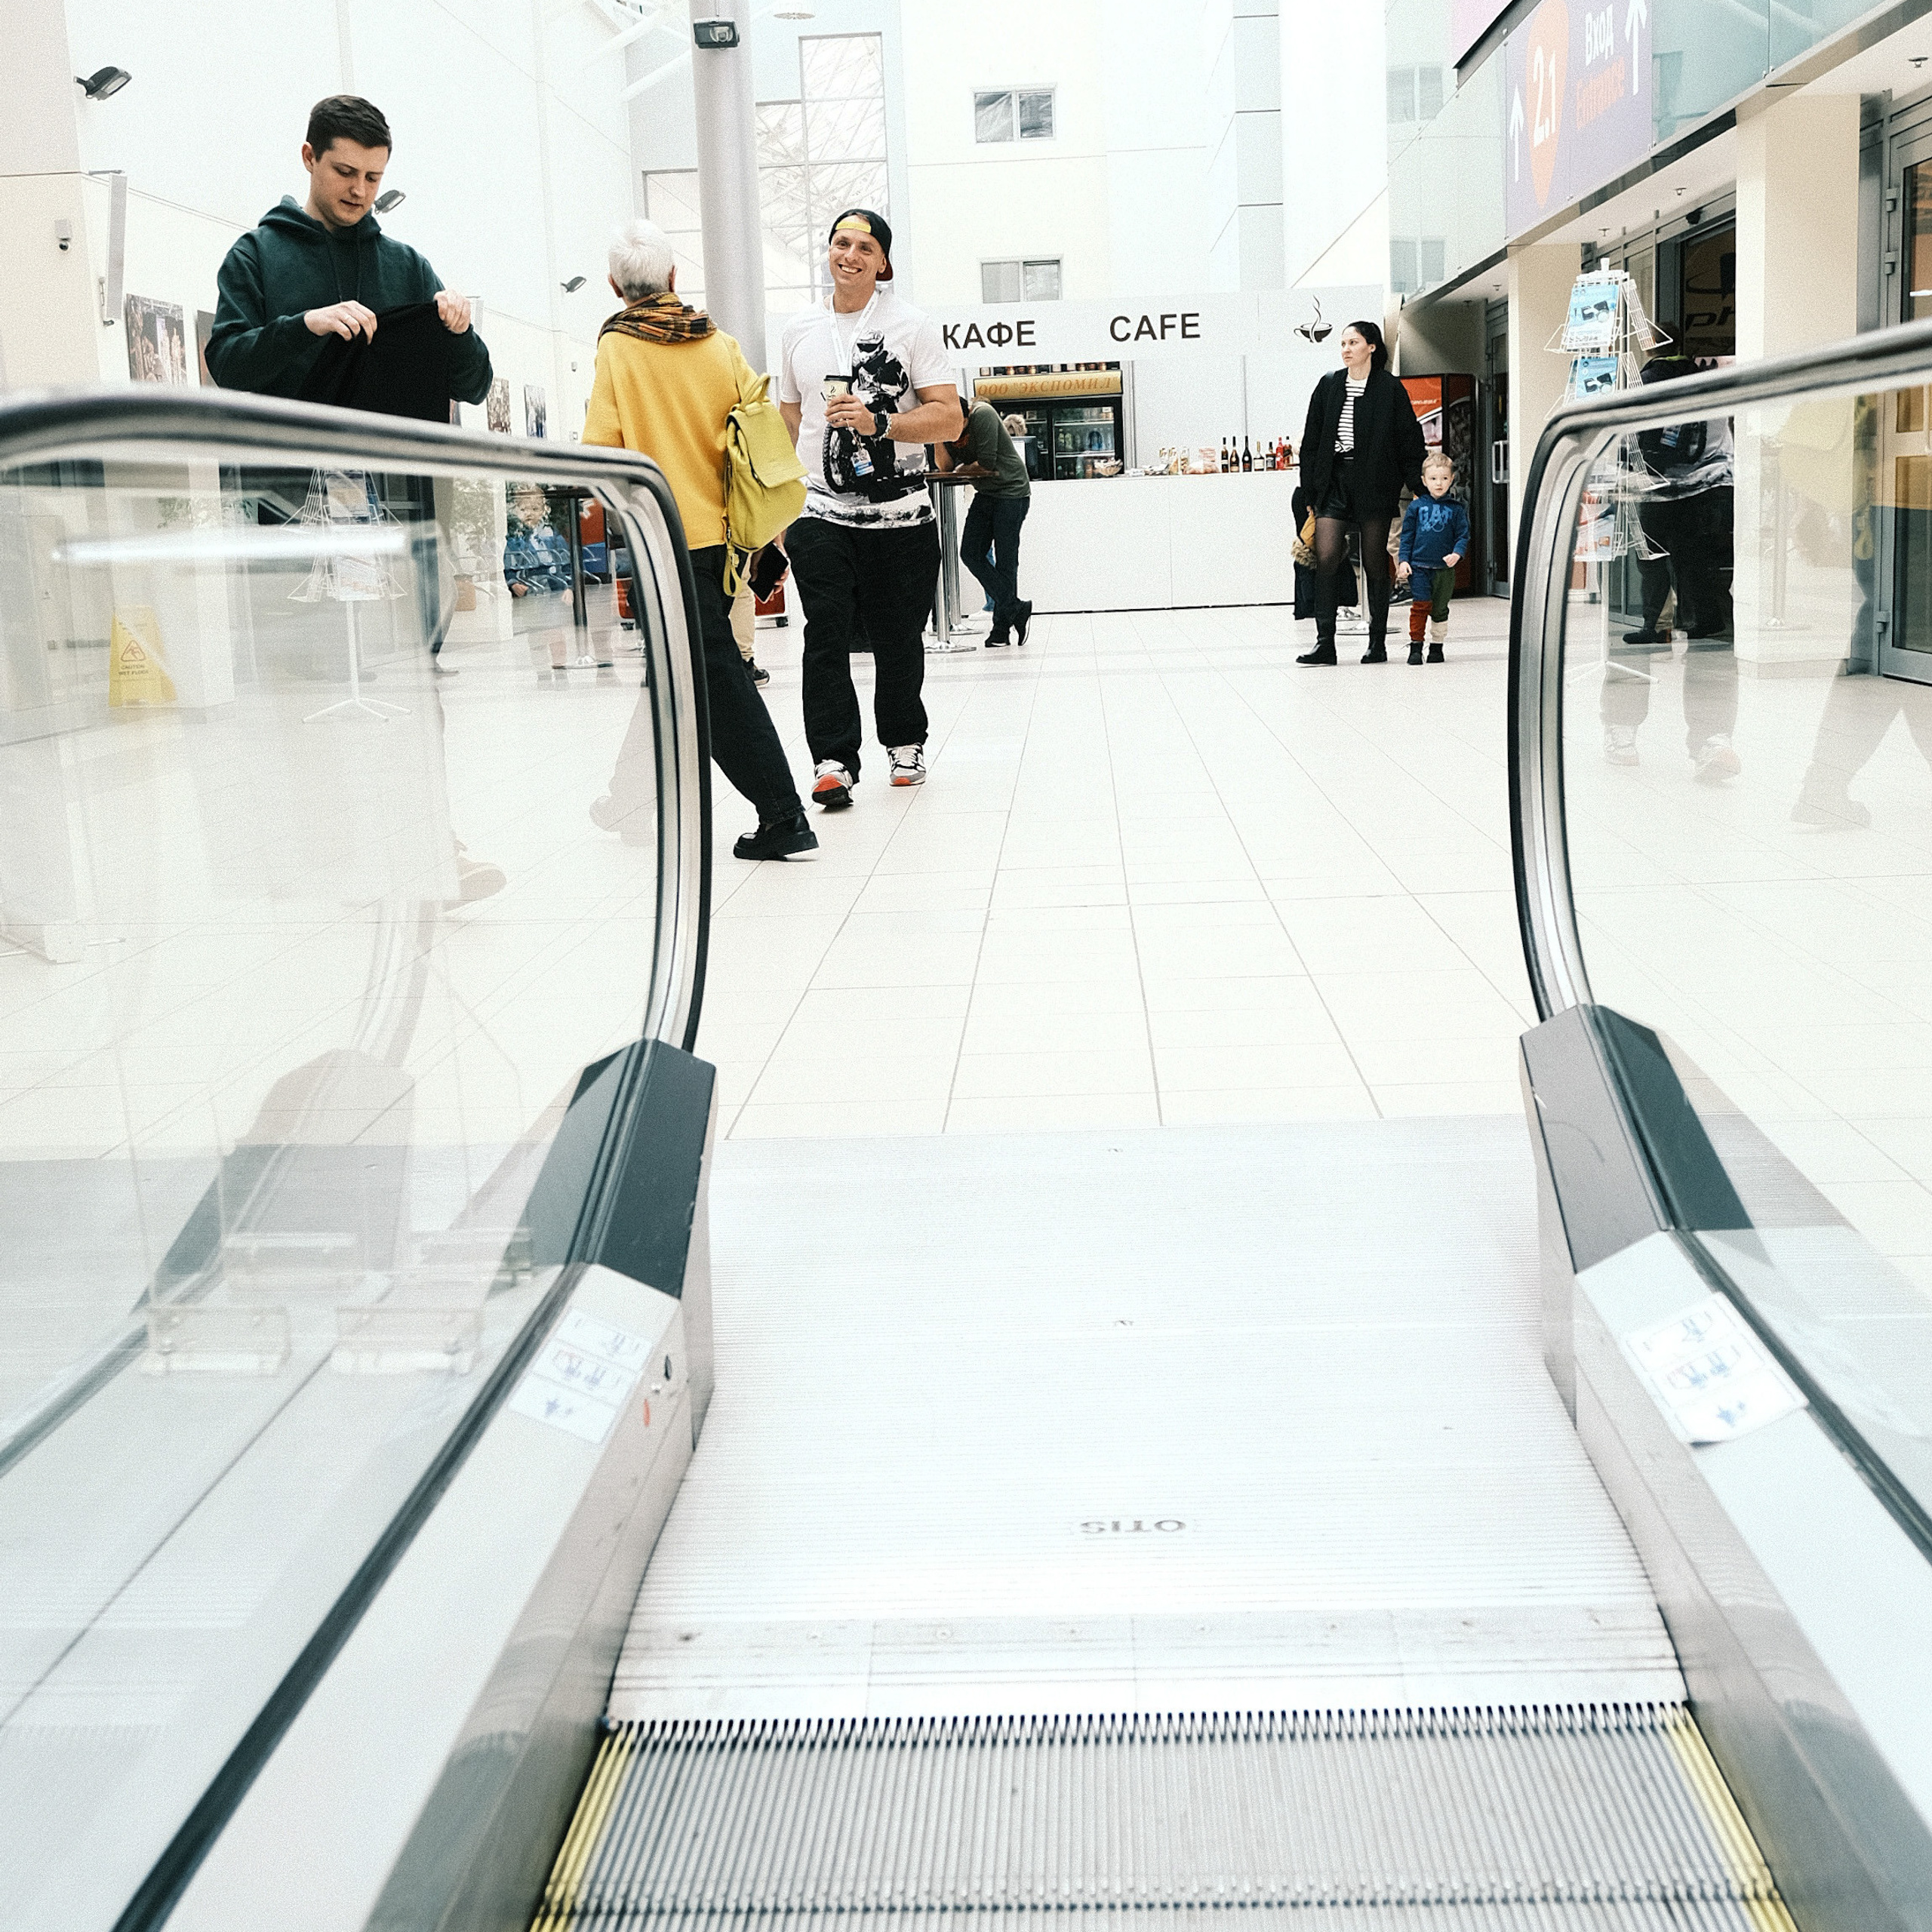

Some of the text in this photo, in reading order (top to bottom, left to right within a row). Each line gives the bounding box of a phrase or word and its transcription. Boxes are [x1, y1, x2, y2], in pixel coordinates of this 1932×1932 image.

[1585, 3, 1614, 67] Вход
[1534, 45, 1555, 148] 2.1
[943, 320, 1036, 349] КАФЕ
[1109, 312, 1201, 342] CAFE
[1081, 1519, 1186, 1534] OTIS
